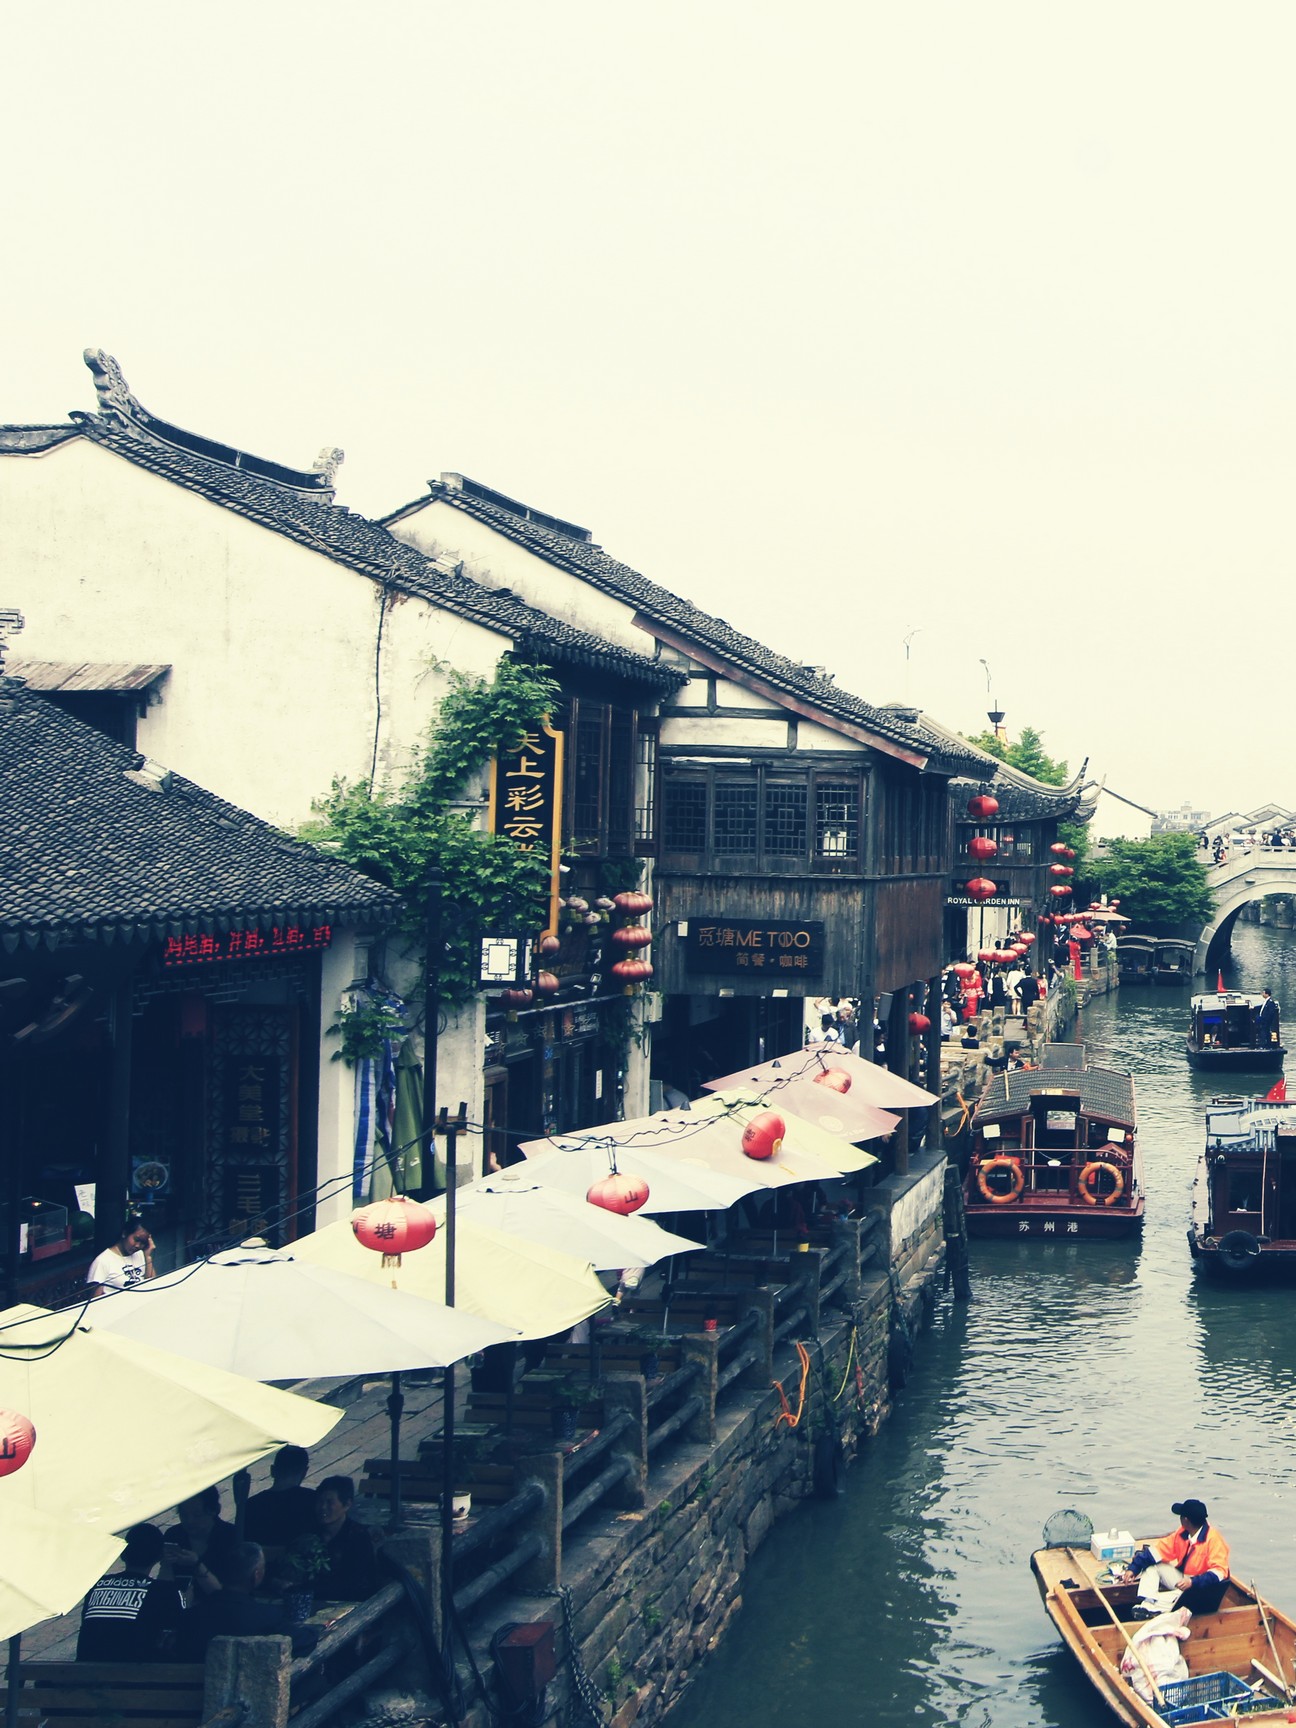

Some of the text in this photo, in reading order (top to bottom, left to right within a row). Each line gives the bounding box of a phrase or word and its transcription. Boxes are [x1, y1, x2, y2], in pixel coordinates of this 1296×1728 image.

[503, 733, 546, 852] 天上彩云
[974, 897, 1007, 905] RDEN
[767, 931, 811, 948] TOO
[624, 1190, 639, 1204] 山
[373, 1222, 397, 1240] 塘
[1018, 1220, 1079, 1233] 苏州港
[97, 1577, 135, 1588] adidas
[87, 1589, 147, 1609] ORIGINALS
